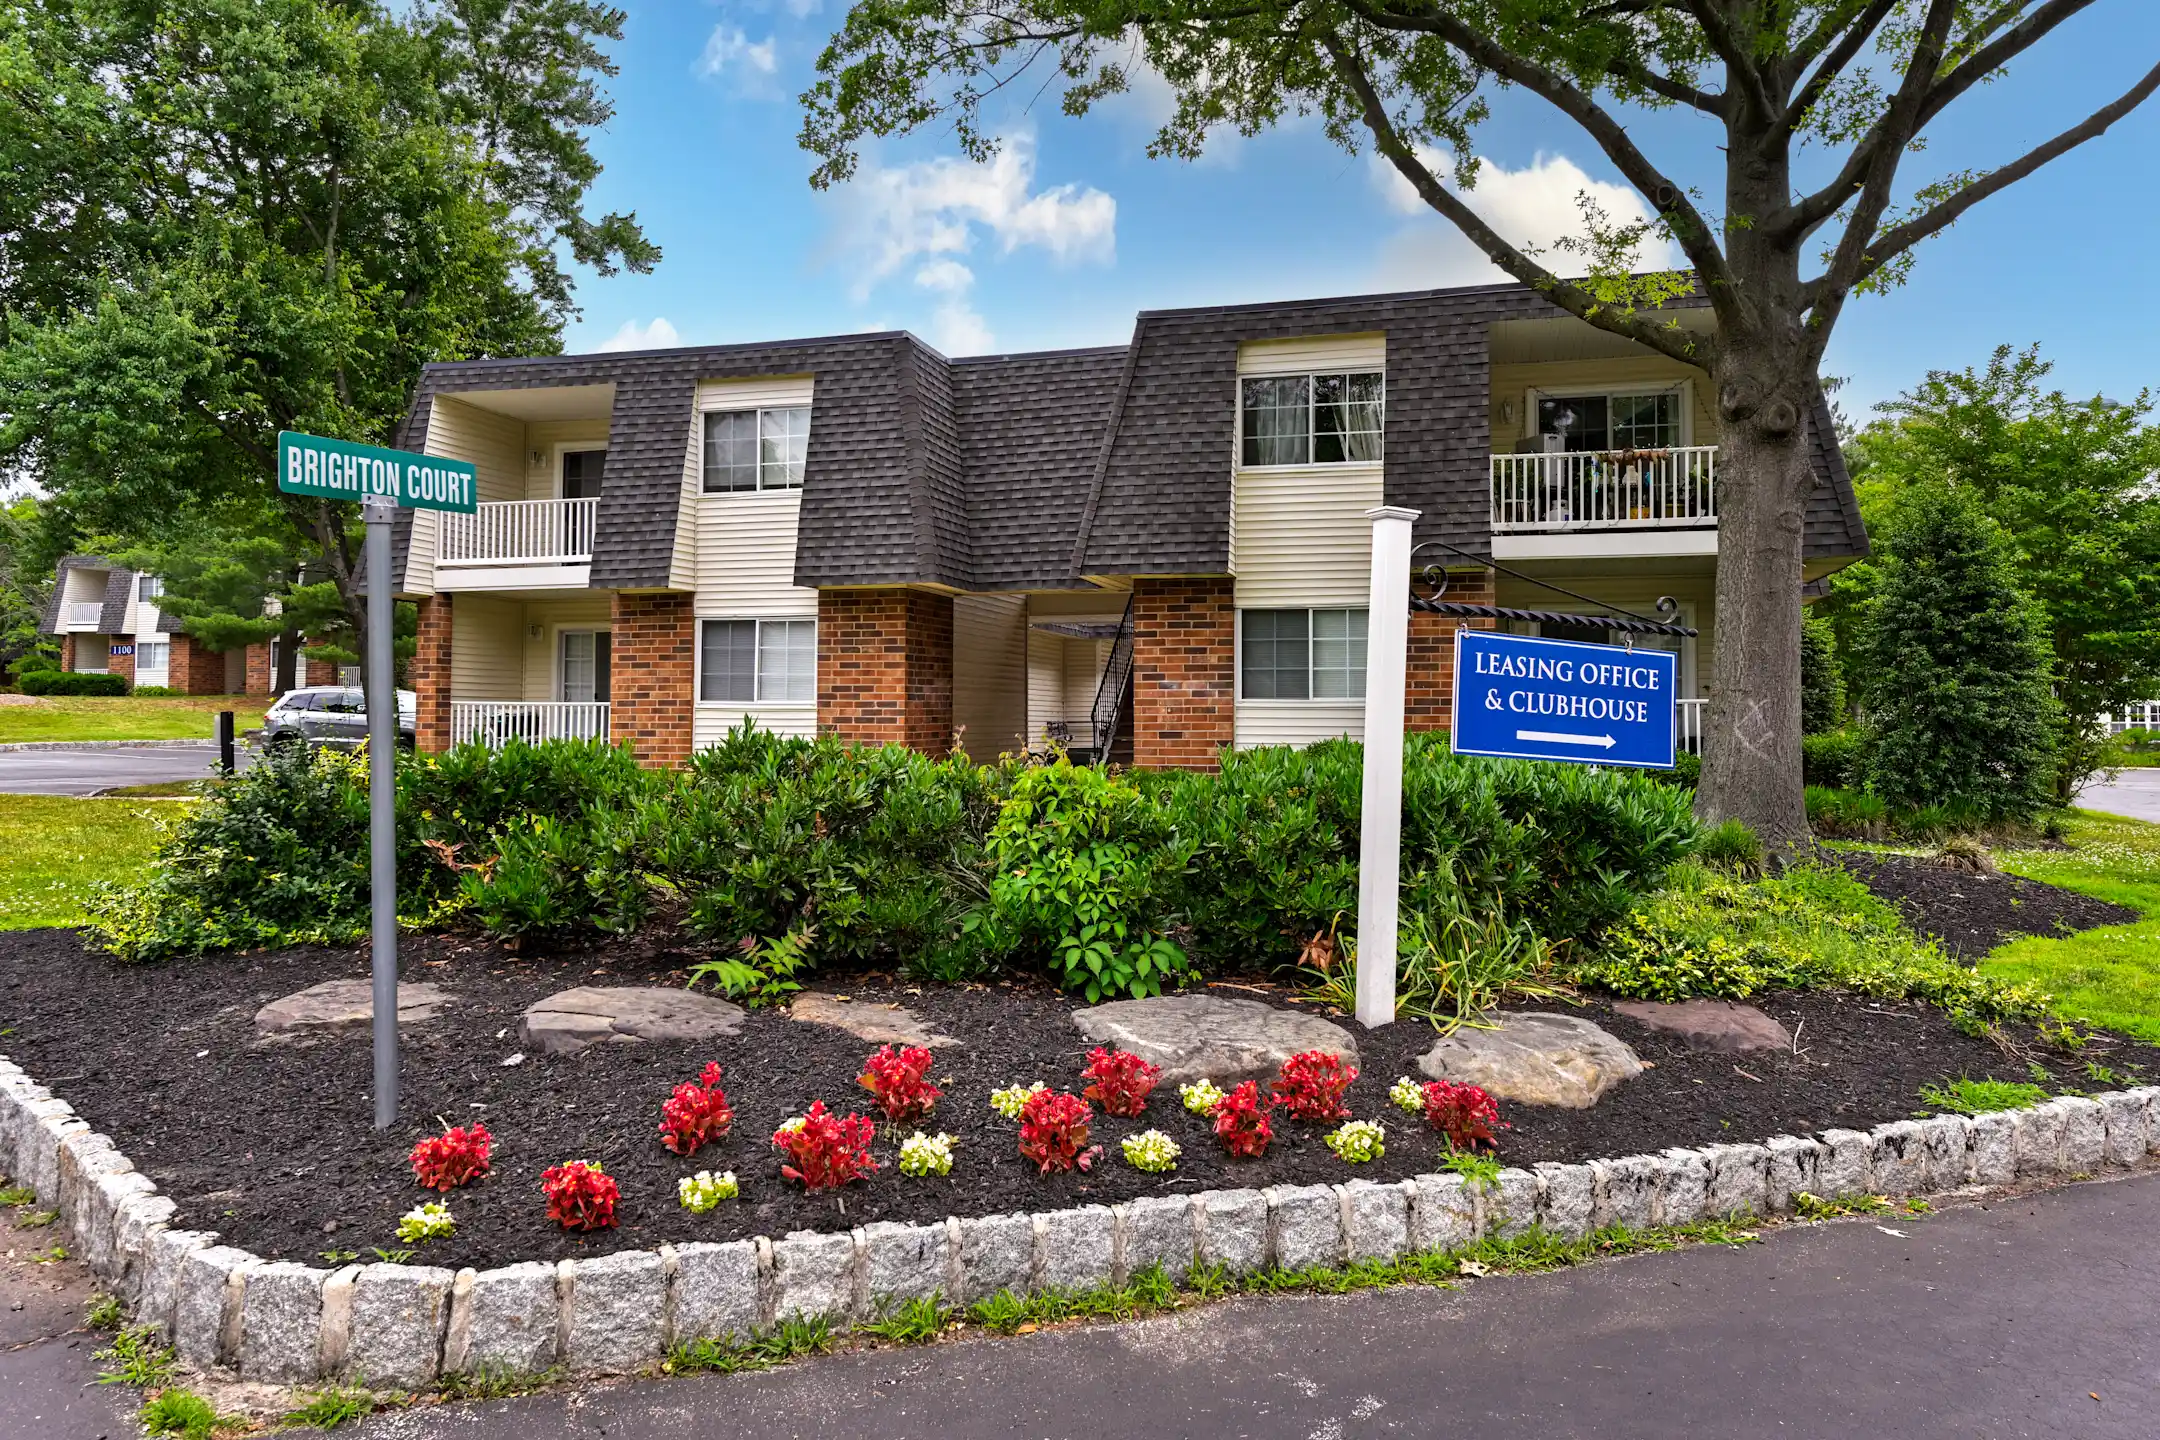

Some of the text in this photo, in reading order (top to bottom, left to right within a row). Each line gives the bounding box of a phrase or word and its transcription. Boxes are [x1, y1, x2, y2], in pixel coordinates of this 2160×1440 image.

[287, 445, 471, 505] BRIGHTON COURT
[113, 645, 132, 654] 1100
[1475, 651, 1660, 690] LEASING OFFICE
[1485, 688, 1648, 723] & CLUBHOUSE
